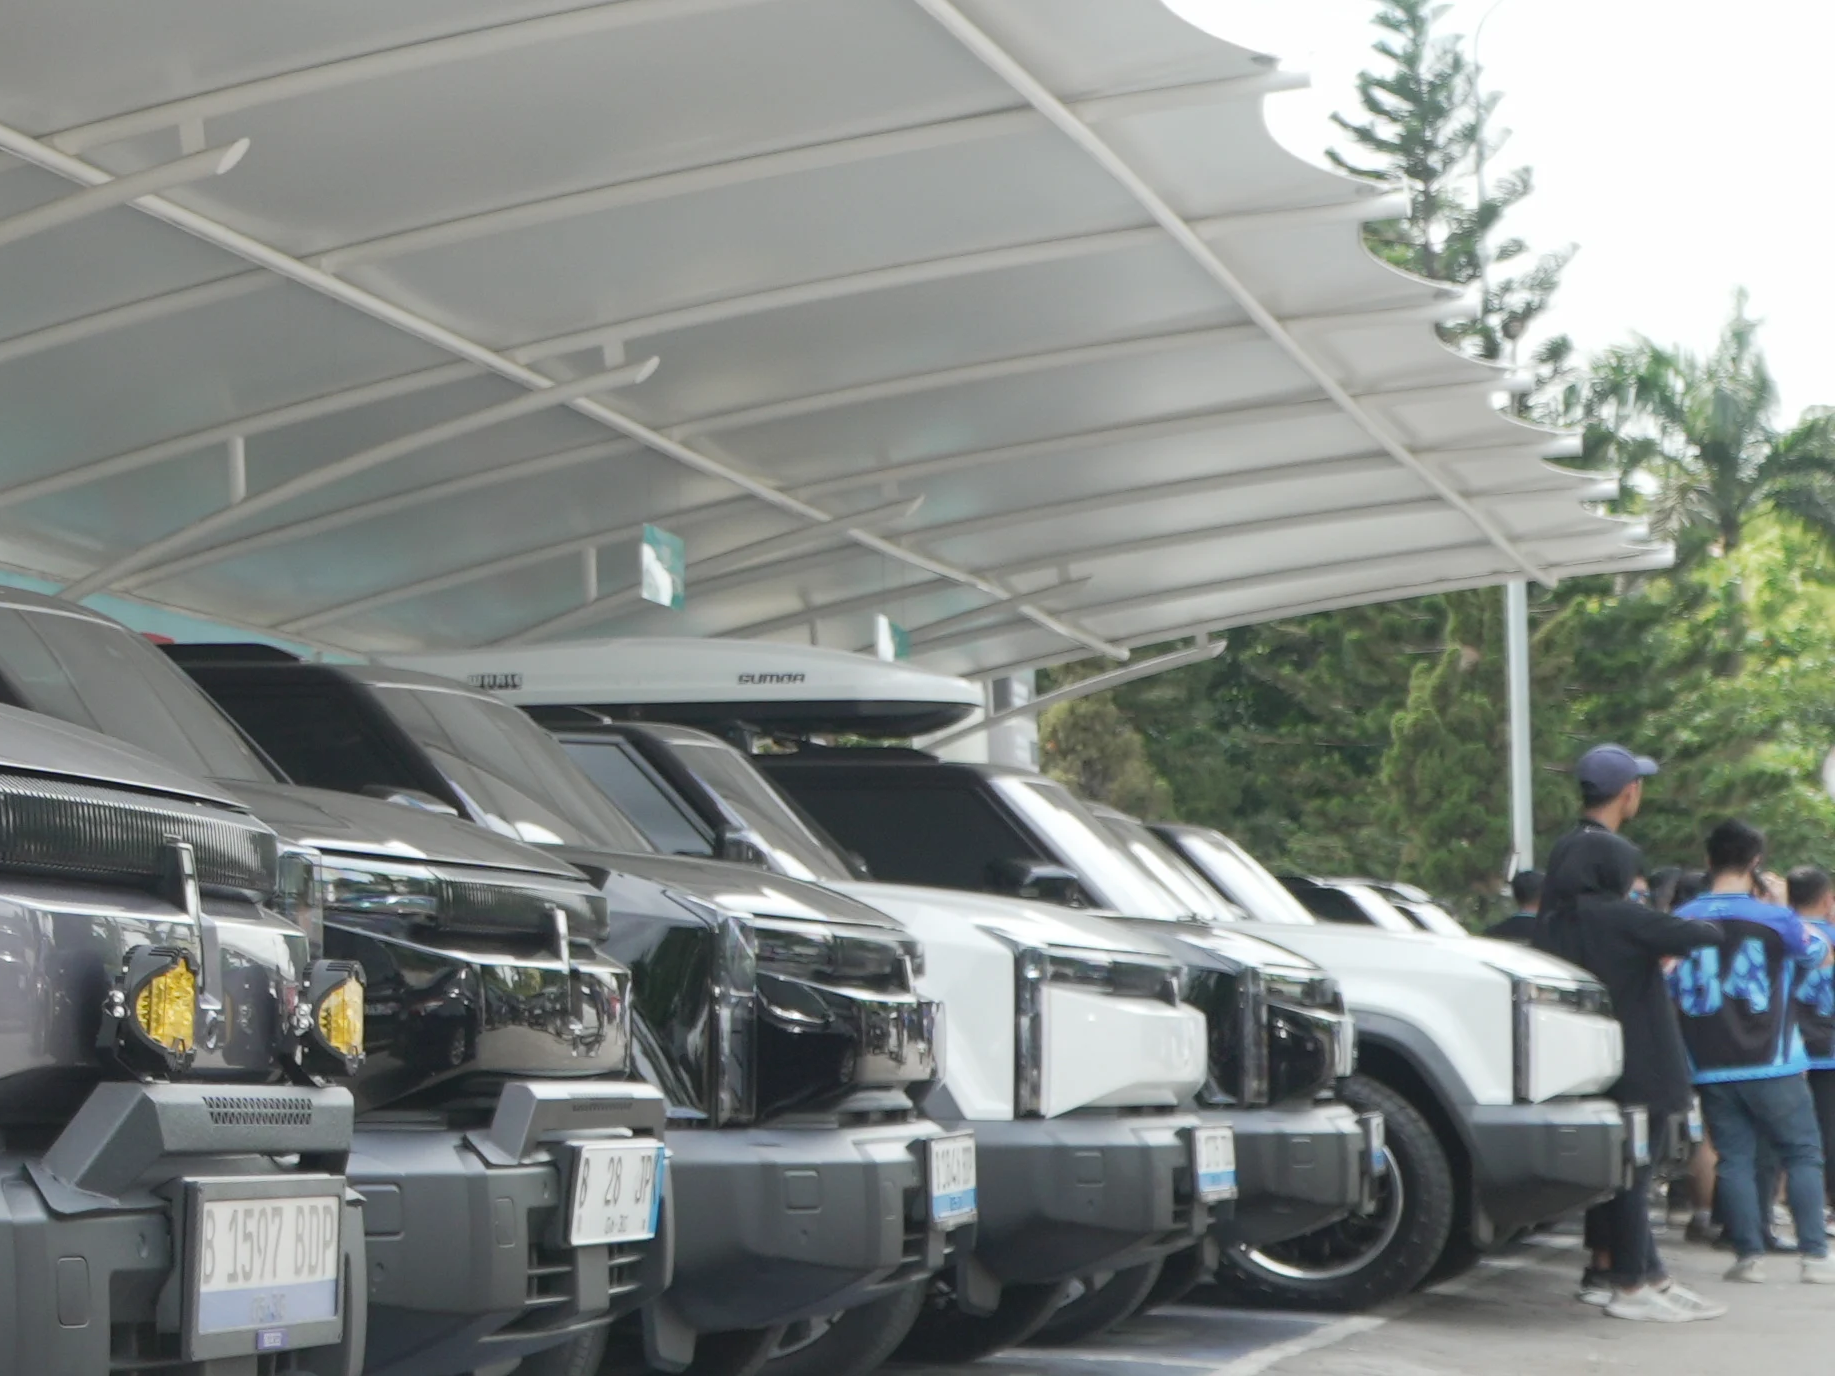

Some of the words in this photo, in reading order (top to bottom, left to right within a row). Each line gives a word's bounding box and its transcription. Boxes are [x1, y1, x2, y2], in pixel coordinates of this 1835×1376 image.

[578, 1157, 591, 1209] B
[604, 1156, 623, 1206] 28
[202, 1208, 217, 1285] B
[227, 1206, 284, 1284] 1597
[294, 1204, 335, 1279] BDP
